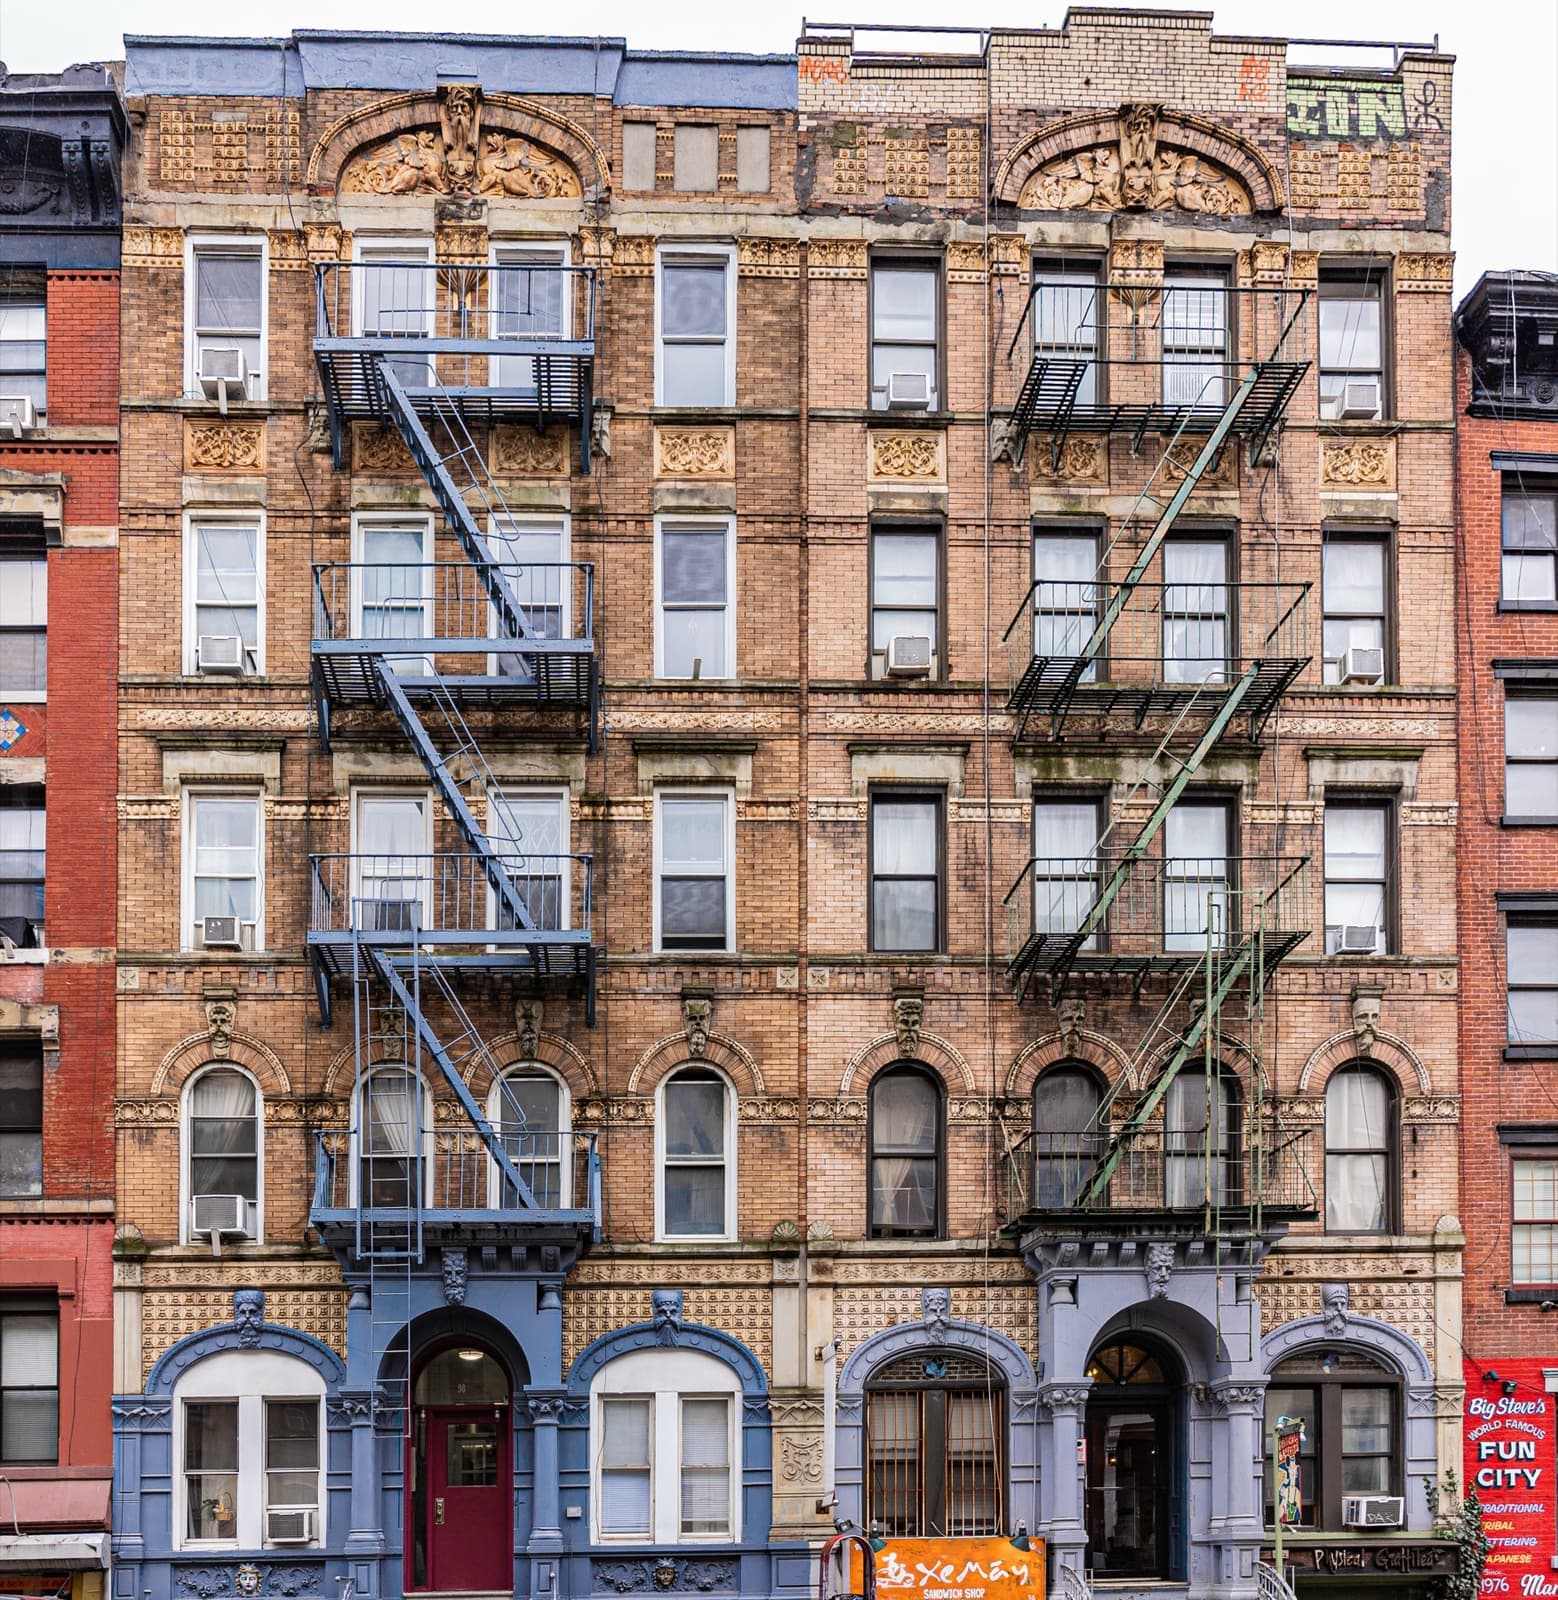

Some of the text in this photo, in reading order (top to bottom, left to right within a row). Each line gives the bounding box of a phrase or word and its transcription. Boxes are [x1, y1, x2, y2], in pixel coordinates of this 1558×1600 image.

[1469, 1397, 1546, 1420] Big Steve's
[1467, 1419, 1546, 1441] WORLD FAMOUS
[1479, 1441, 1536, 1461] FUN
[1476, 1468, 1542, 1488] CITY
[1485, 1537, 1538, 1546] ETTERING
[1485, 1554, 1532, 1563] APANESE
[923, 1588, 985, 1599] SANDWICH SHOP
[1481, 1577, 1510, 1593] 1976
